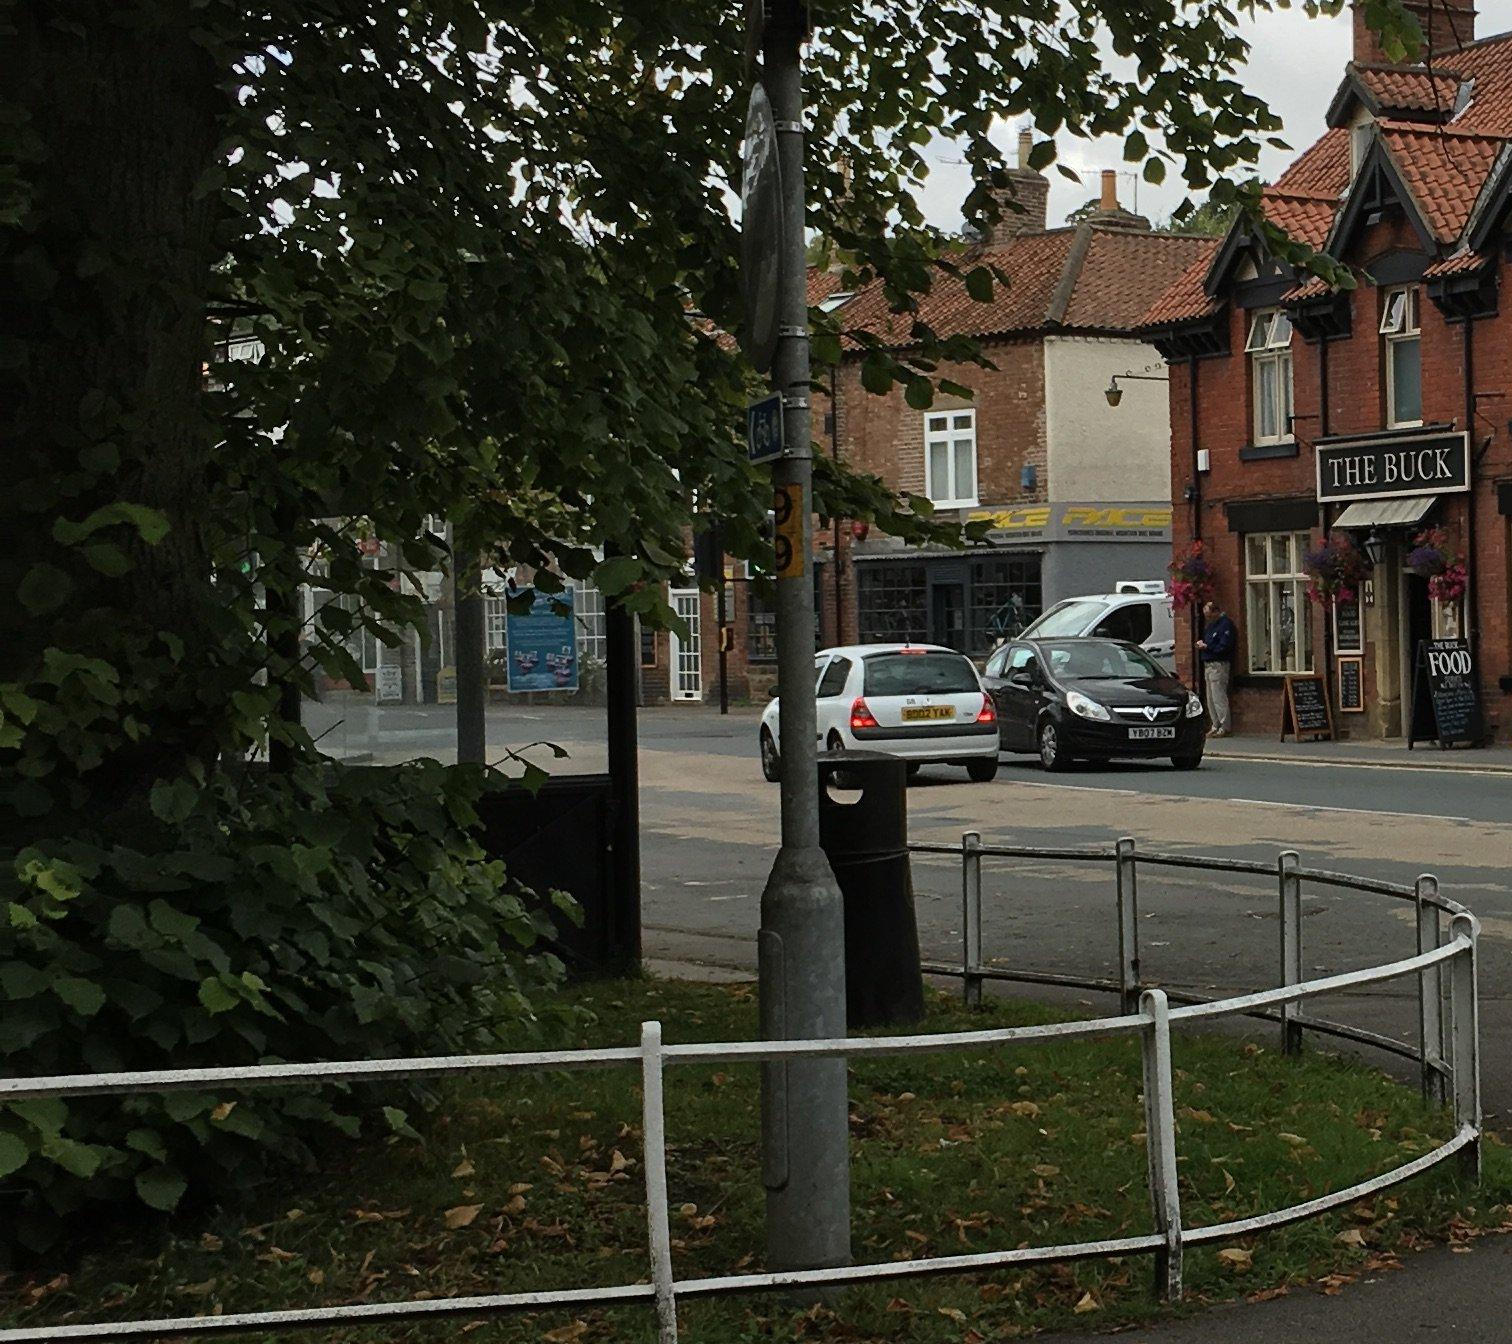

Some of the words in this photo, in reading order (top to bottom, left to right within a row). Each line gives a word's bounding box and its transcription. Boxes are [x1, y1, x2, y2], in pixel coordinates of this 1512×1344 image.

[1328, 455, 1377, 487] THE
[1383, 448, 1453, 483] BUCK
[1428, 650, 1472, 676] FOOD
